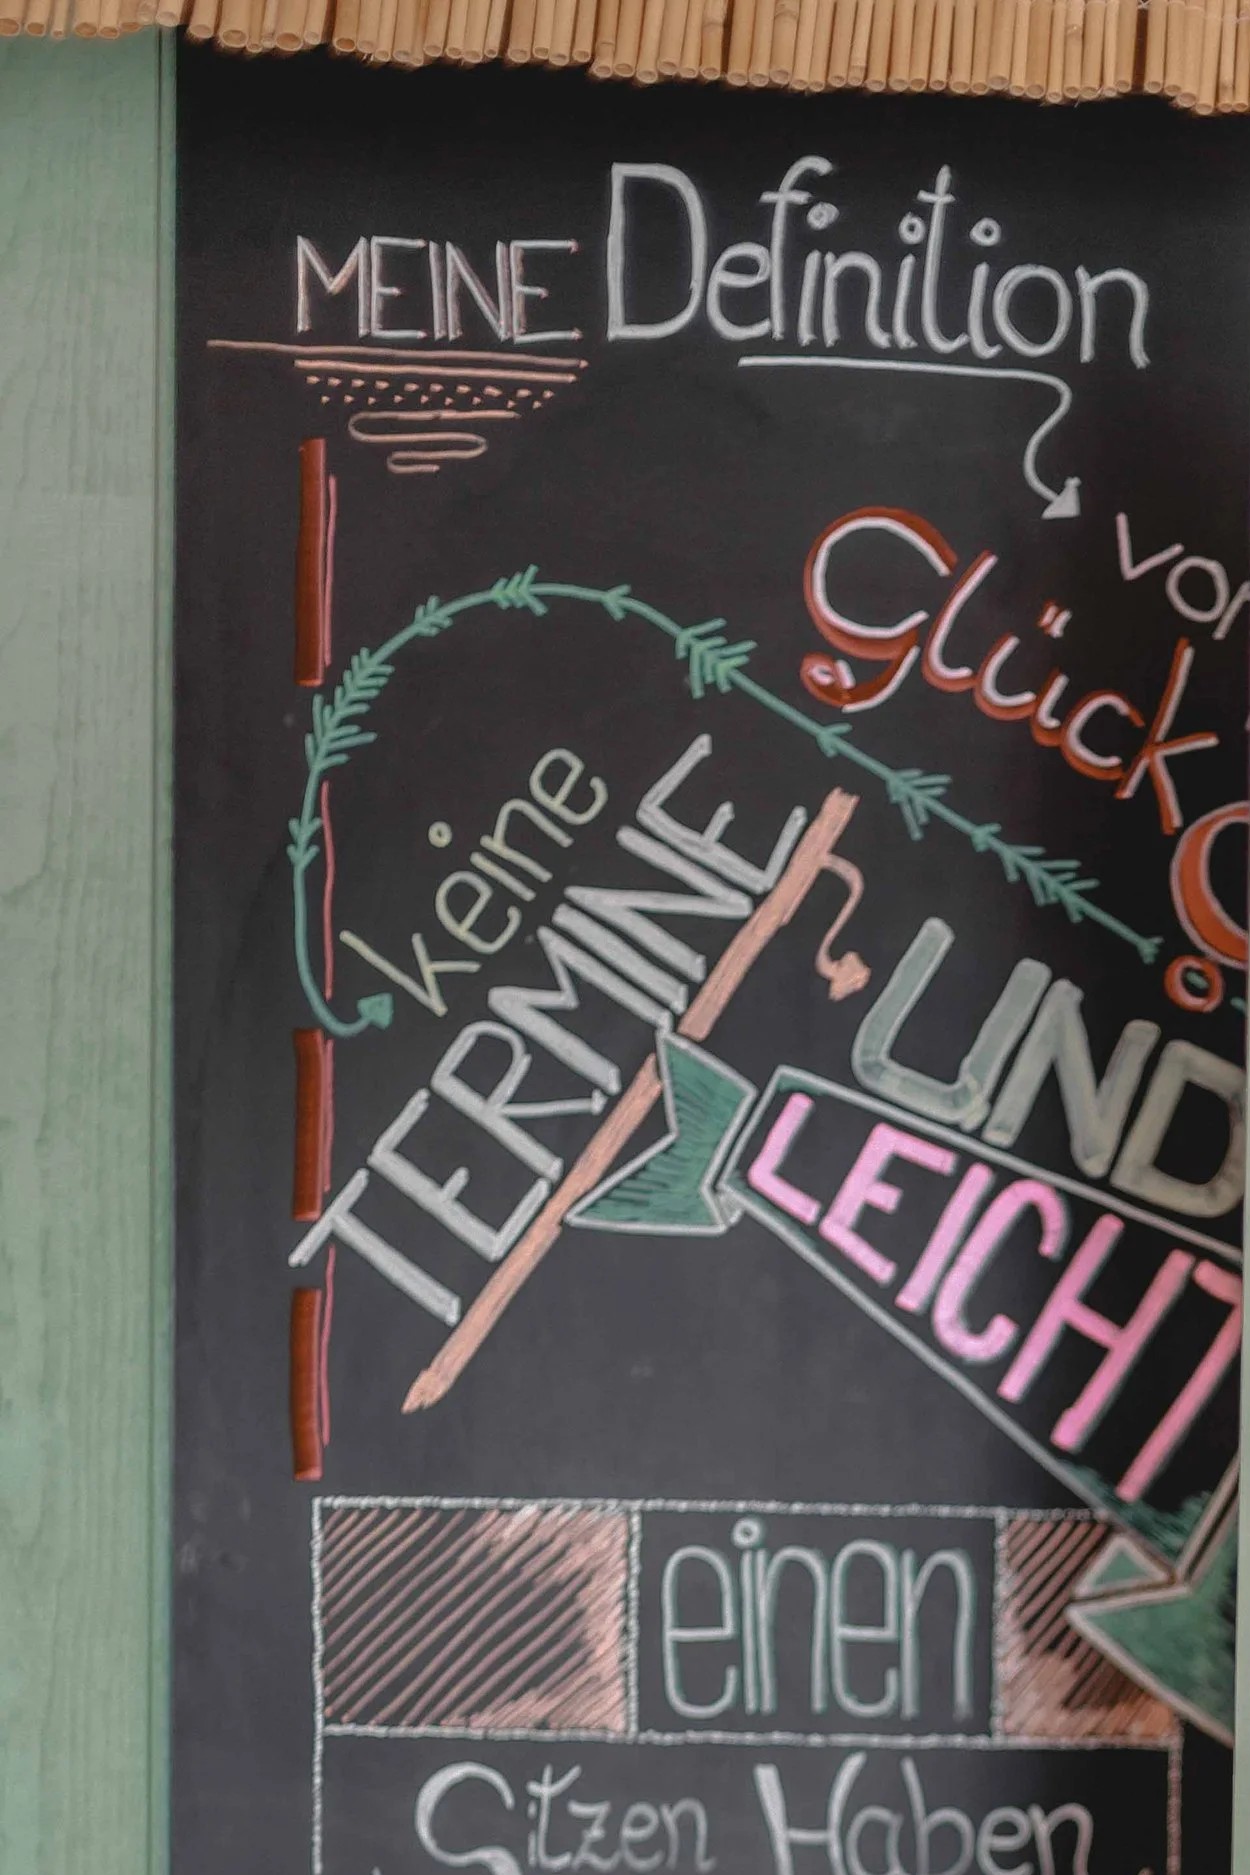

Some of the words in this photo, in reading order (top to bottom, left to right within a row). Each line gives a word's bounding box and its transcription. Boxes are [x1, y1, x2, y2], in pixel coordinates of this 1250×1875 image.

[296, 235, 582, 340] MEINE
[607, 157, 1150, 368] Definition
[340, 746, 608, 1016] keine
[289, 734, 806, 1325] TERMINE
[851, 917, 1246, 1217] UND
[748, 1093, 1243, 1501] LEICHT
[662, 1519, 975, 1719] einen
